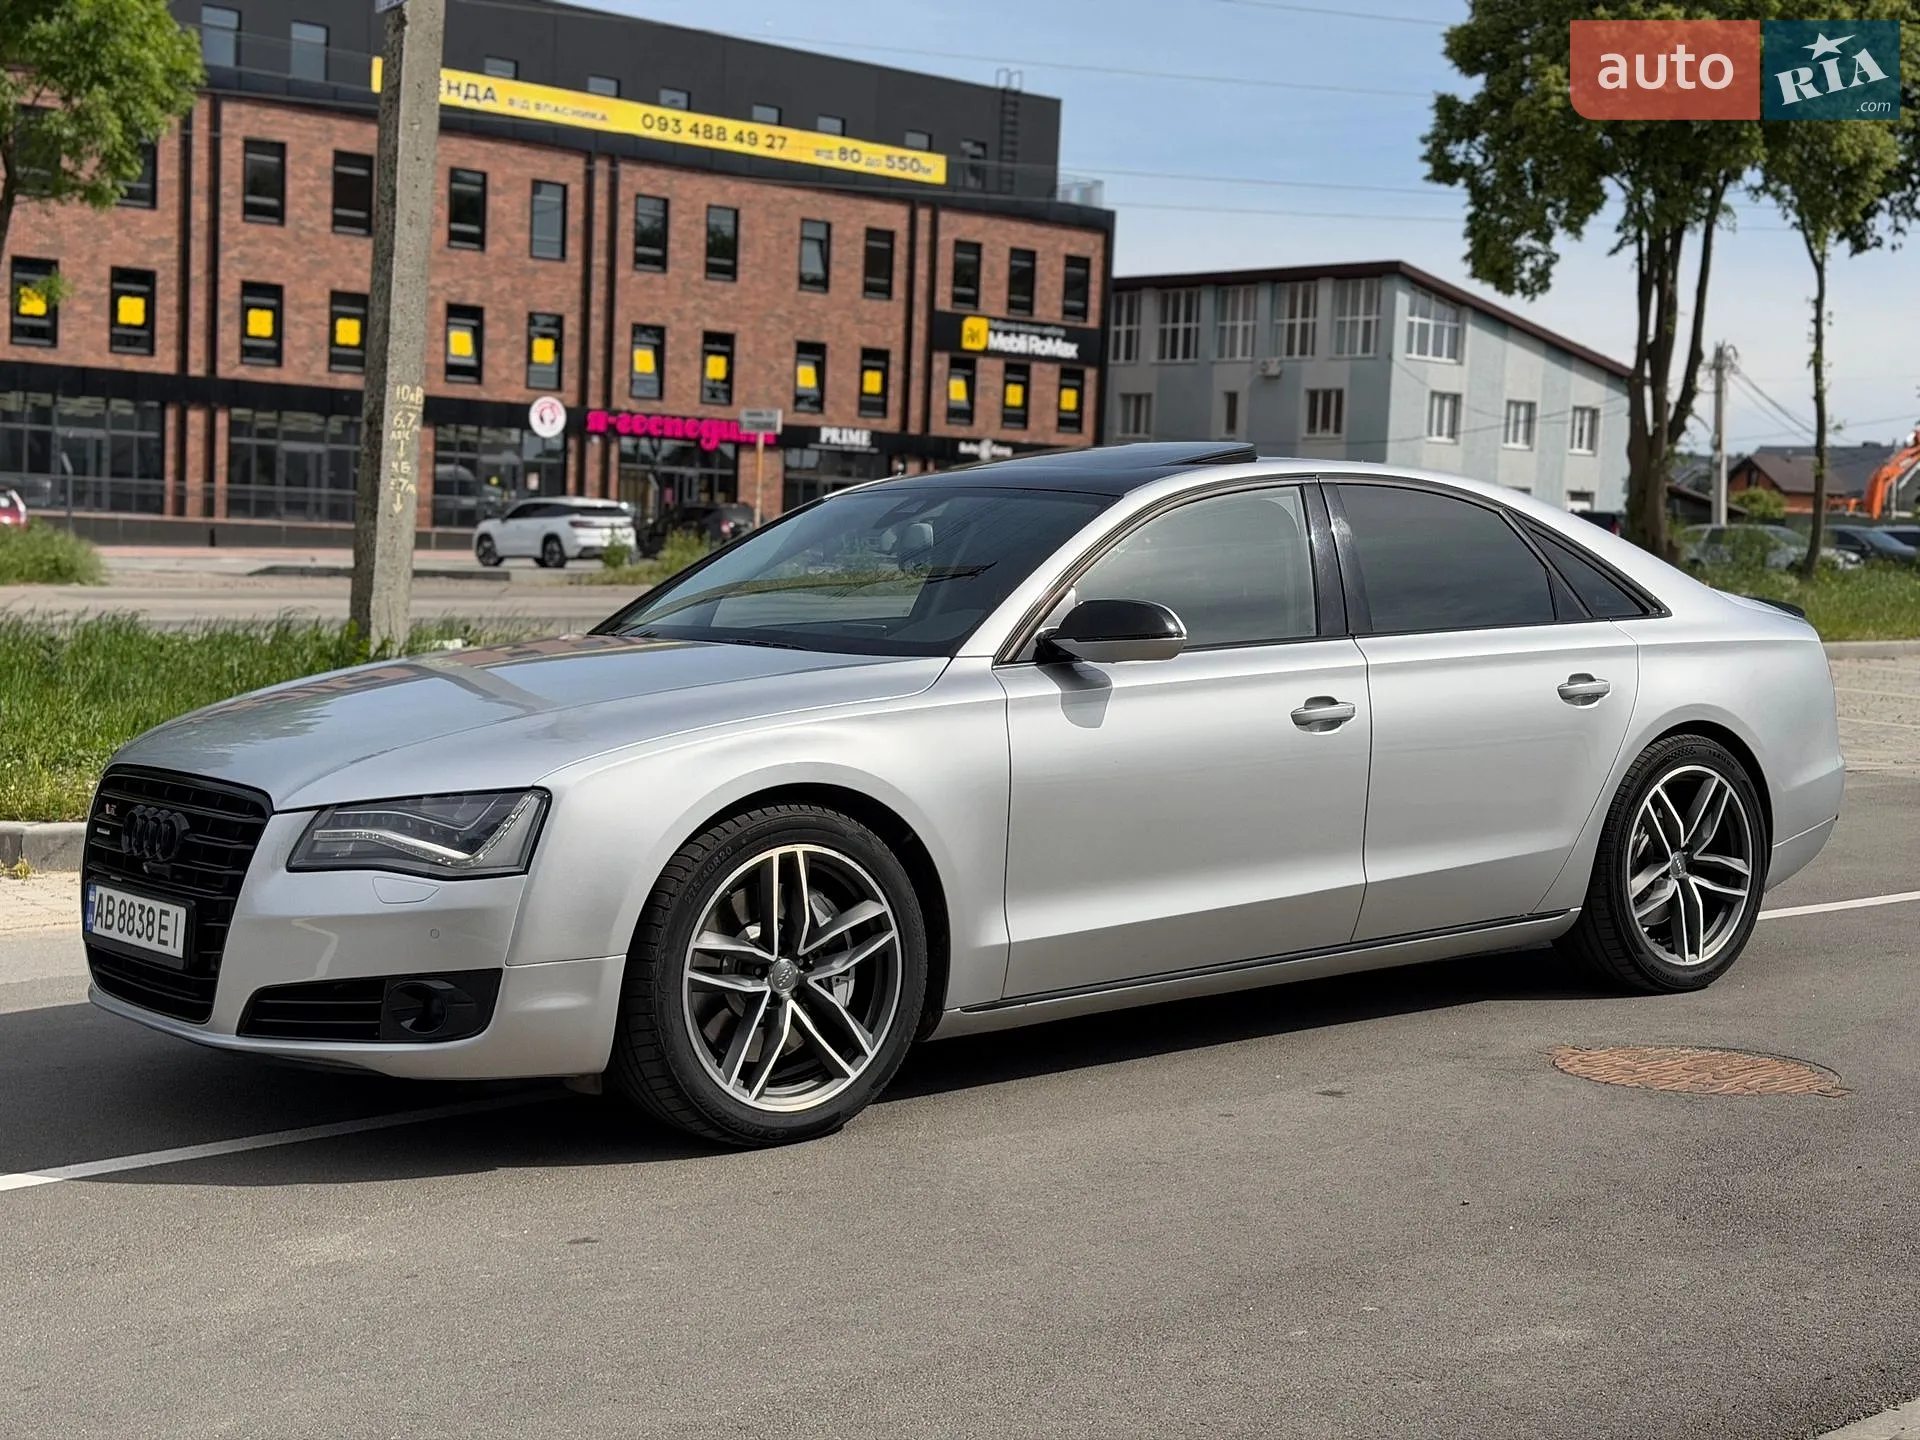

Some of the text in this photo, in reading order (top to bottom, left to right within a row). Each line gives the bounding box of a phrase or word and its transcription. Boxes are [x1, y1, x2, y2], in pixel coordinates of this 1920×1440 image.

[641, 113, 683, 135] 093
[688, 122, 728, 142] 488
[733, 129, 759, 147] 49
[765, 133, 788, 152] 27
[838, 146, 862, 164] 80
[820, 425, 873, 447] PRIME
